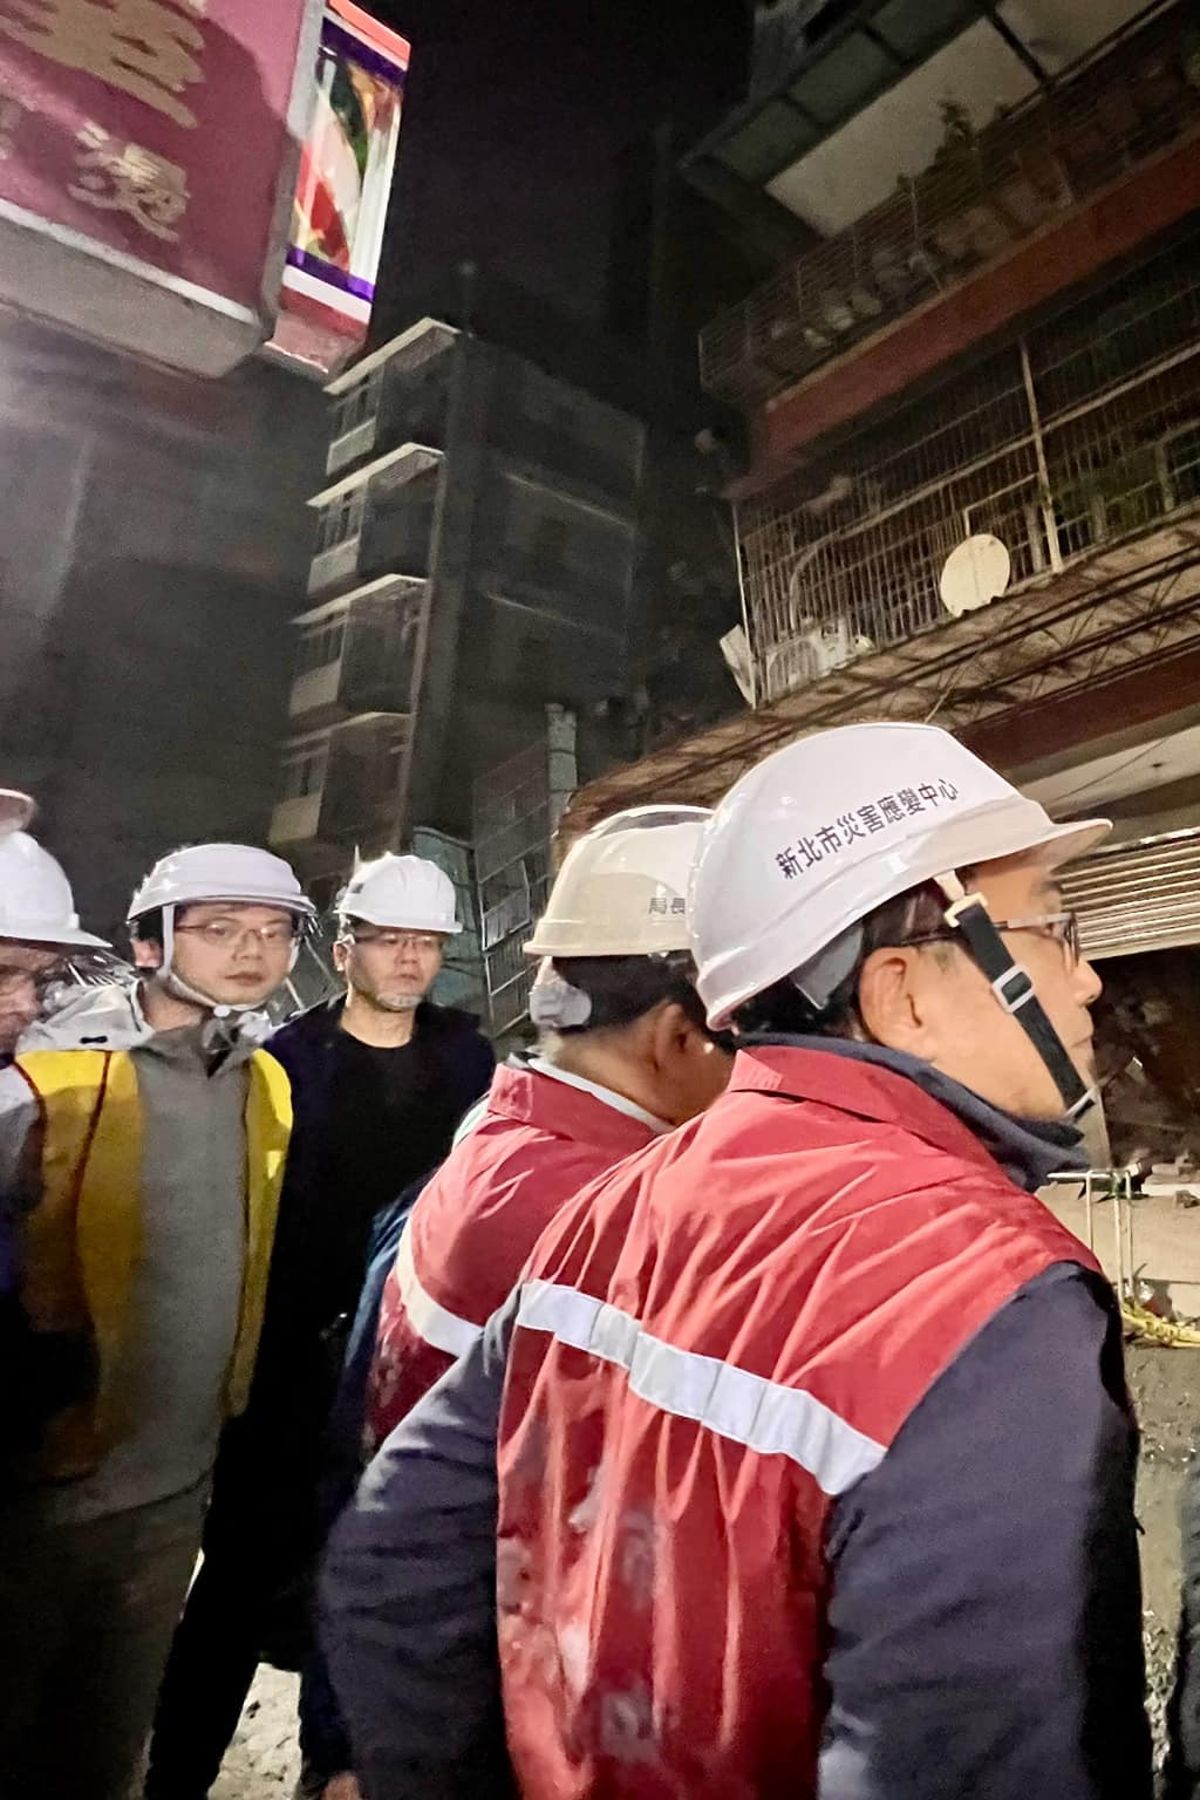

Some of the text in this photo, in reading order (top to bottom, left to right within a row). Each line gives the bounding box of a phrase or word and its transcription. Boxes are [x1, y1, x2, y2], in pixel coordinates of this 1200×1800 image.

[774, 778, 959, 880] 新北市災害應變中心
[648, 897, 686, 914] 局長
